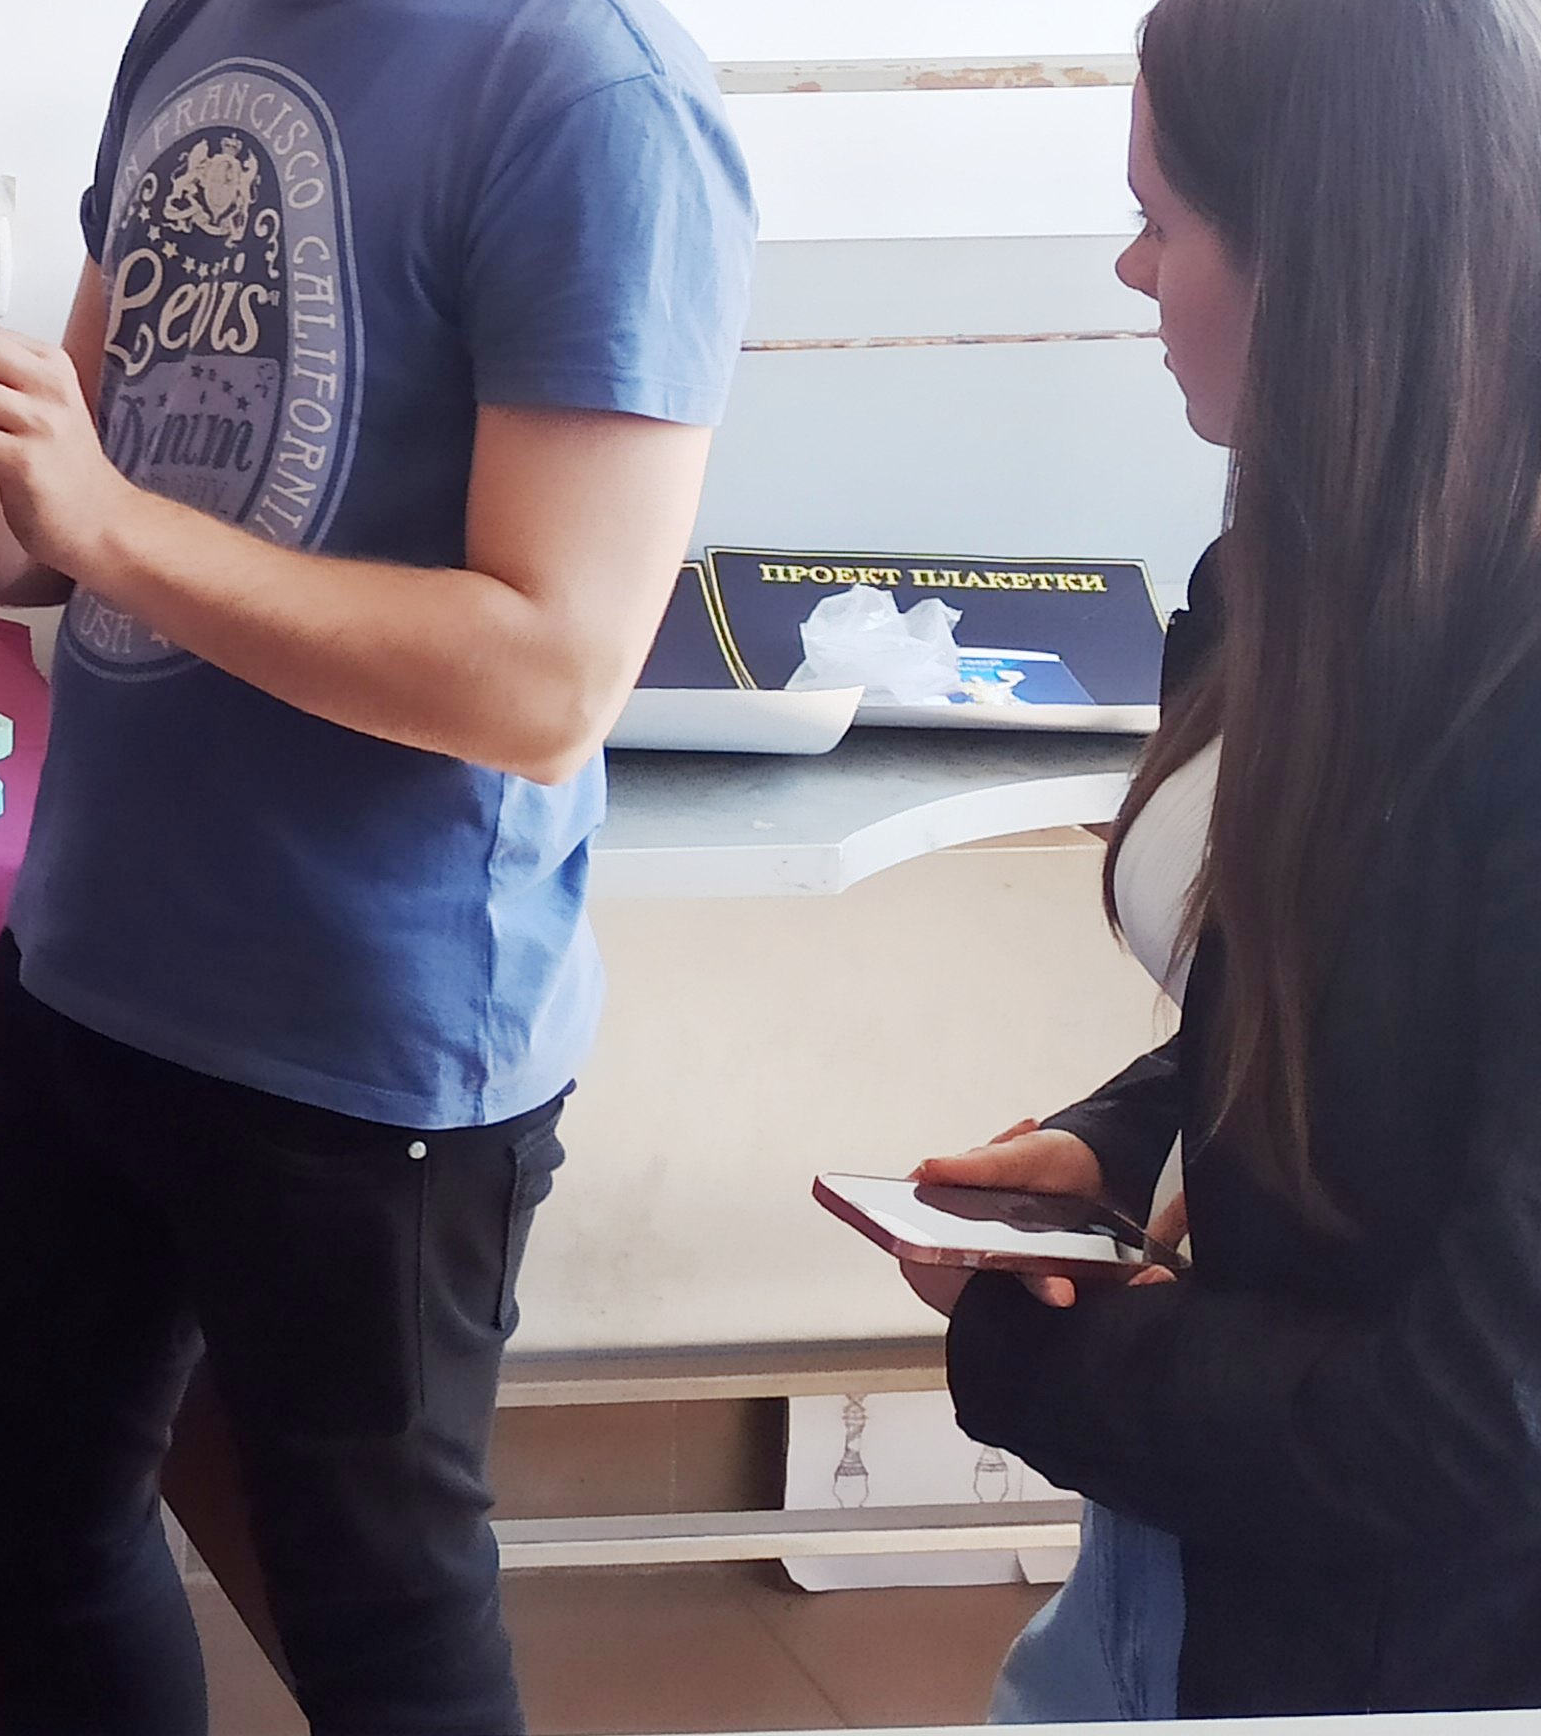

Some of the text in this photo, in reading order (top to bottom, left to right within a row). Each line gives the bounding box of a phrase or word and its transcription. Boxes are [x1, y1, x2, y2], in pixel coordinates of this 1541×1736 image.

[152, 82, 326, 210] FRANCISCO
[760, 563, 1109, 593] ПРОЕКТ ПЛАКЕТКИ
